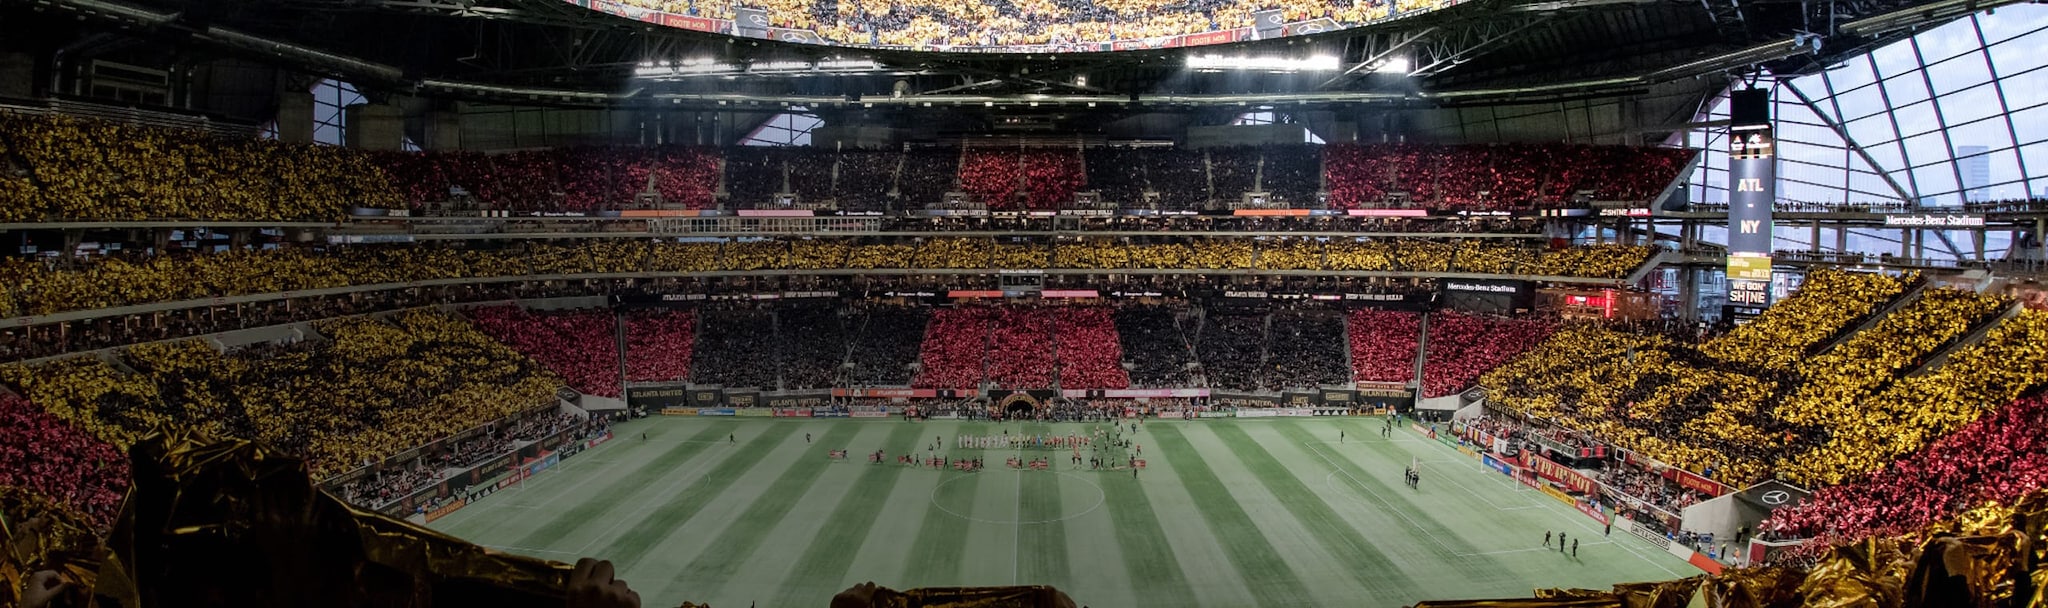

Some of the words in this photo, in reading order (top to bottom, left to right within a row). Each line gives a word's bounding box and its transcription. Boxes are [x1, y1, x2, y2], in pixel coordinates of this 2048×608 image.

[1738, 178, 1764, 192] ATL
[1885, 214, 1946, 226] Mercedes-Benz
[1947, 214, 1983, 226] Stadium
[1740, 219, 1760, 234] NY
[1447, 283, 1490, 292] Mercedes-Benz
[1490, 285, 1516, 293] Stadium
[1732, 281, 1747, 290] WE
[1747, 282, 1766, 291] GON'
[1729, 290, 1765, 306] SHINE
[632, 390, 659, 398] ATLANTA
[659, 389, 683, 397] UNITED
